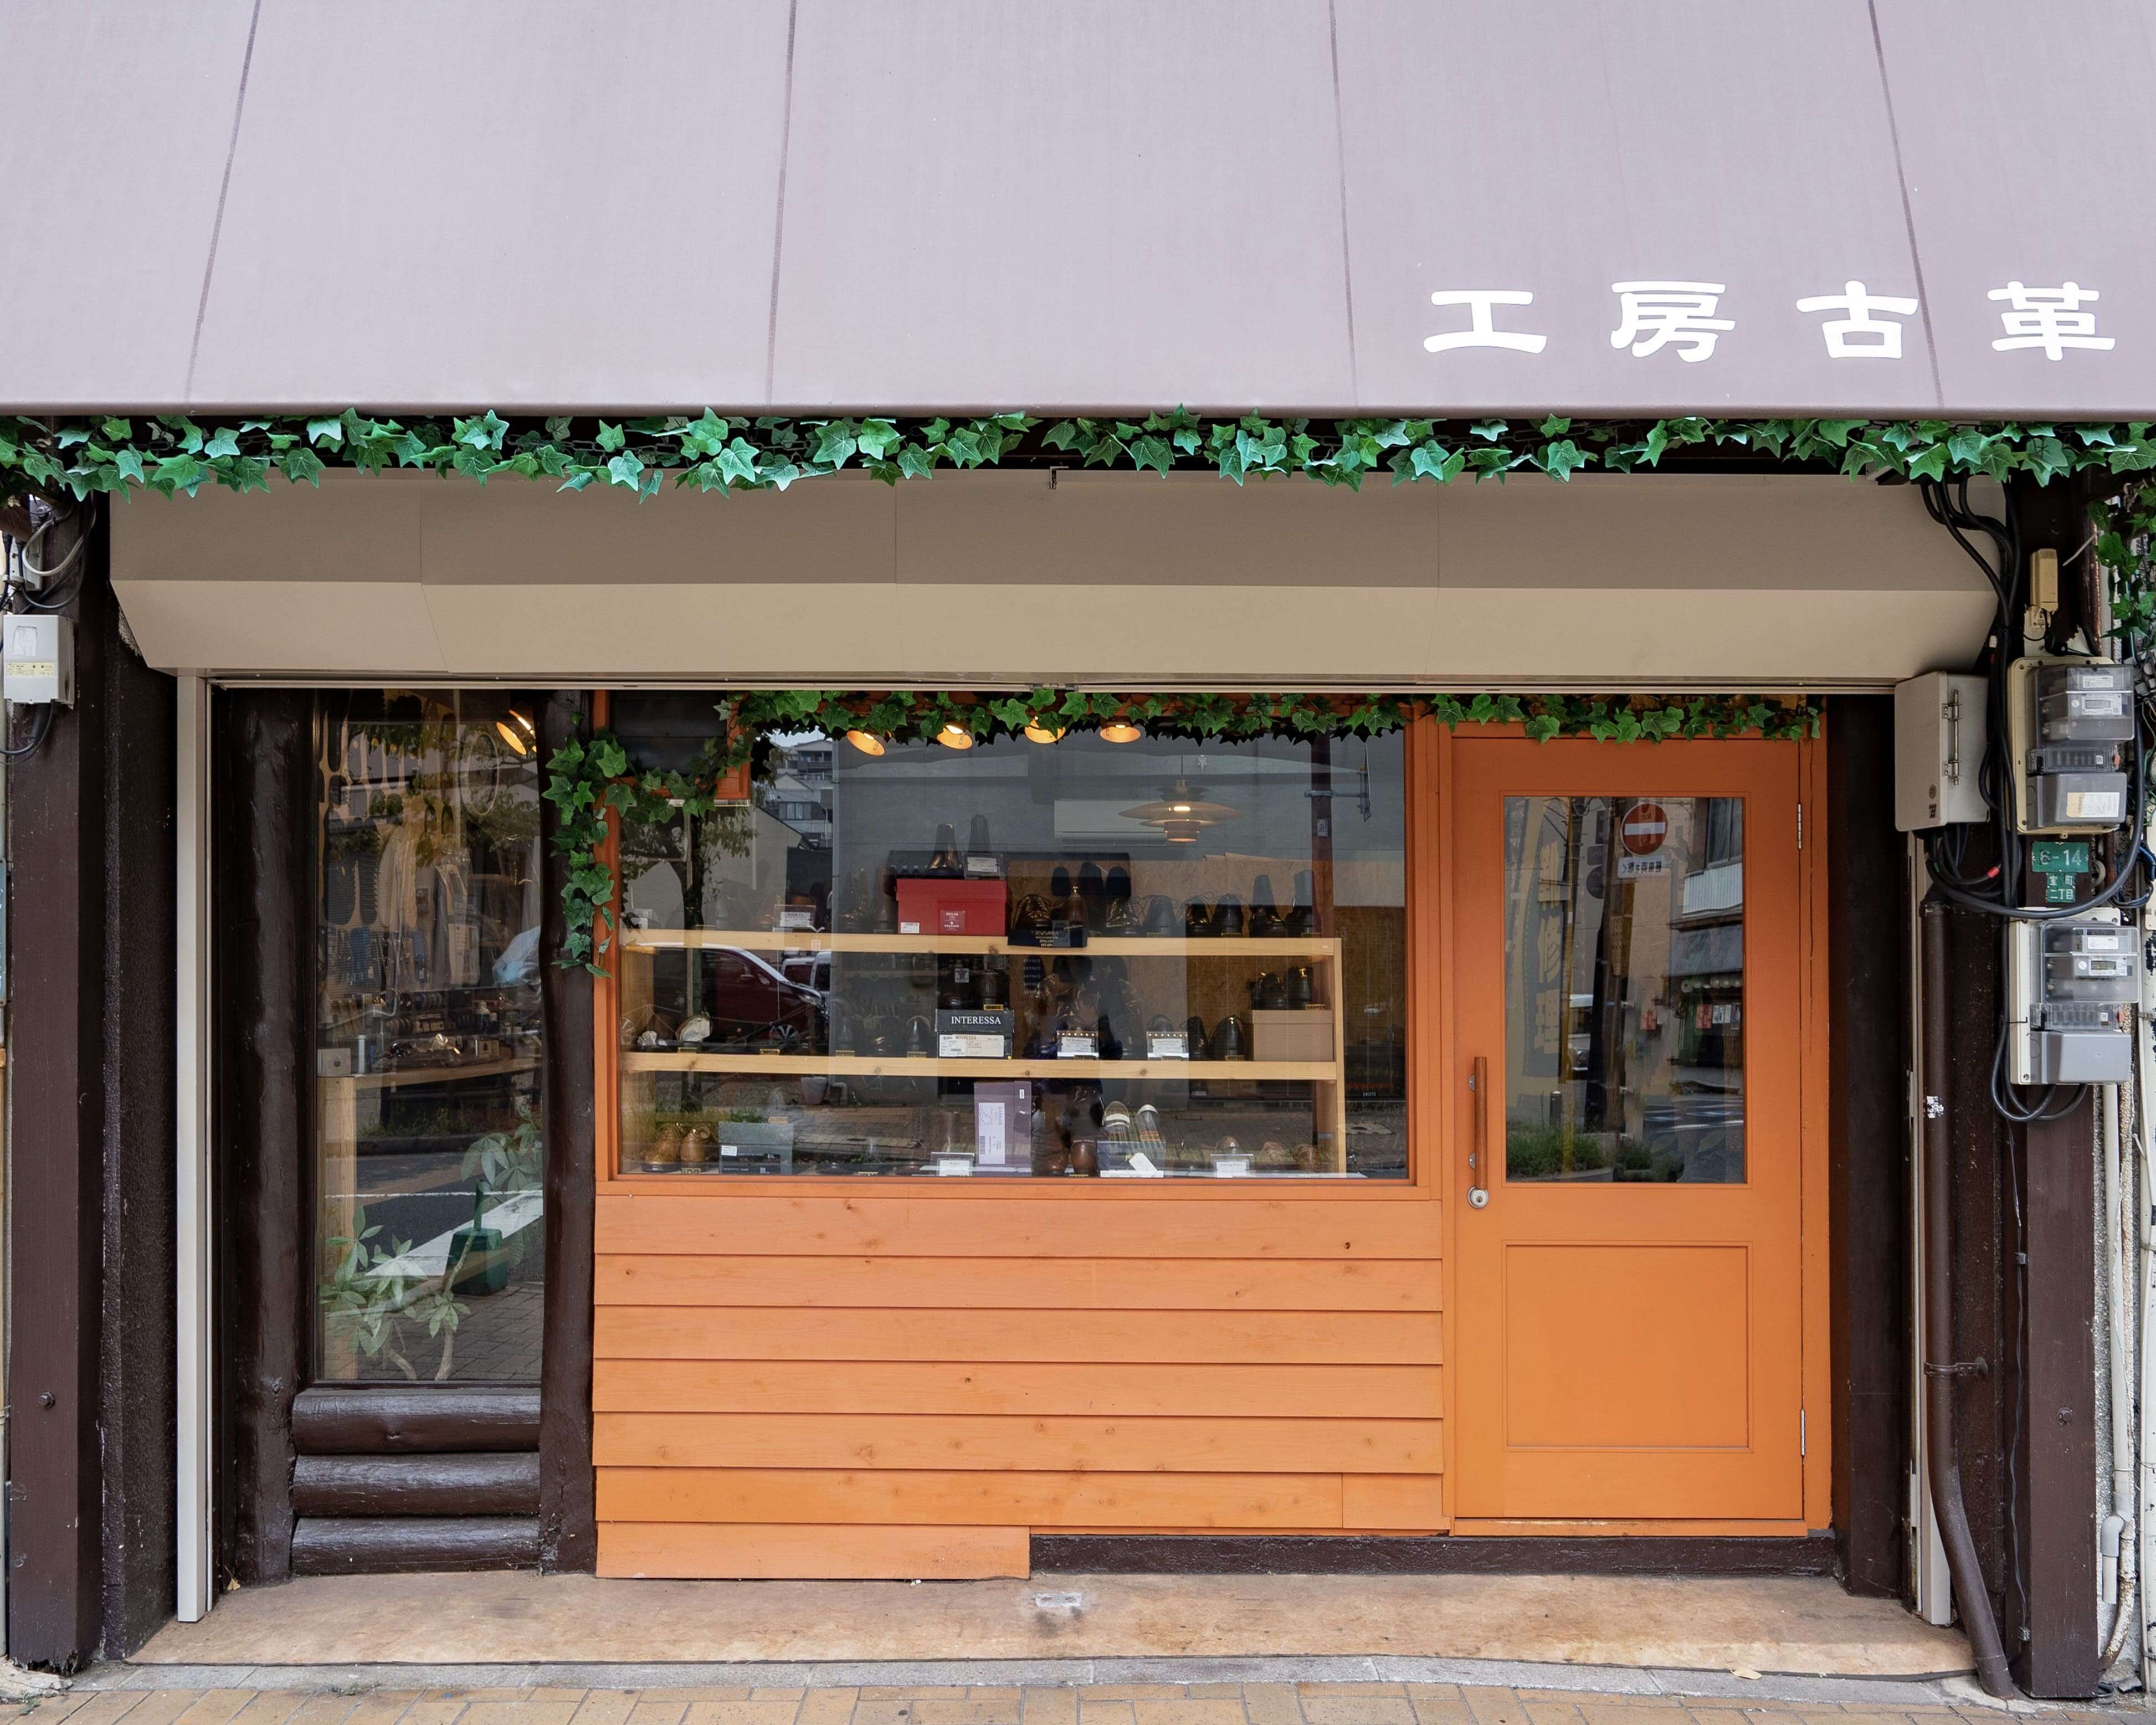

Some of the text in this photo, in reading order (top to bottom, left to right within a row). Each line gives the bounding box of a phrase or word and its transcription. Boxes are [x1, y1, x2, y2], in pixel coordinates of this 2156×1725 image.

[1423, 279, 2117, 363] 工房古革
[2050, 888, 2073, 900] 二丁目
[951, 1015, 1002, 1025] INTERESSA
